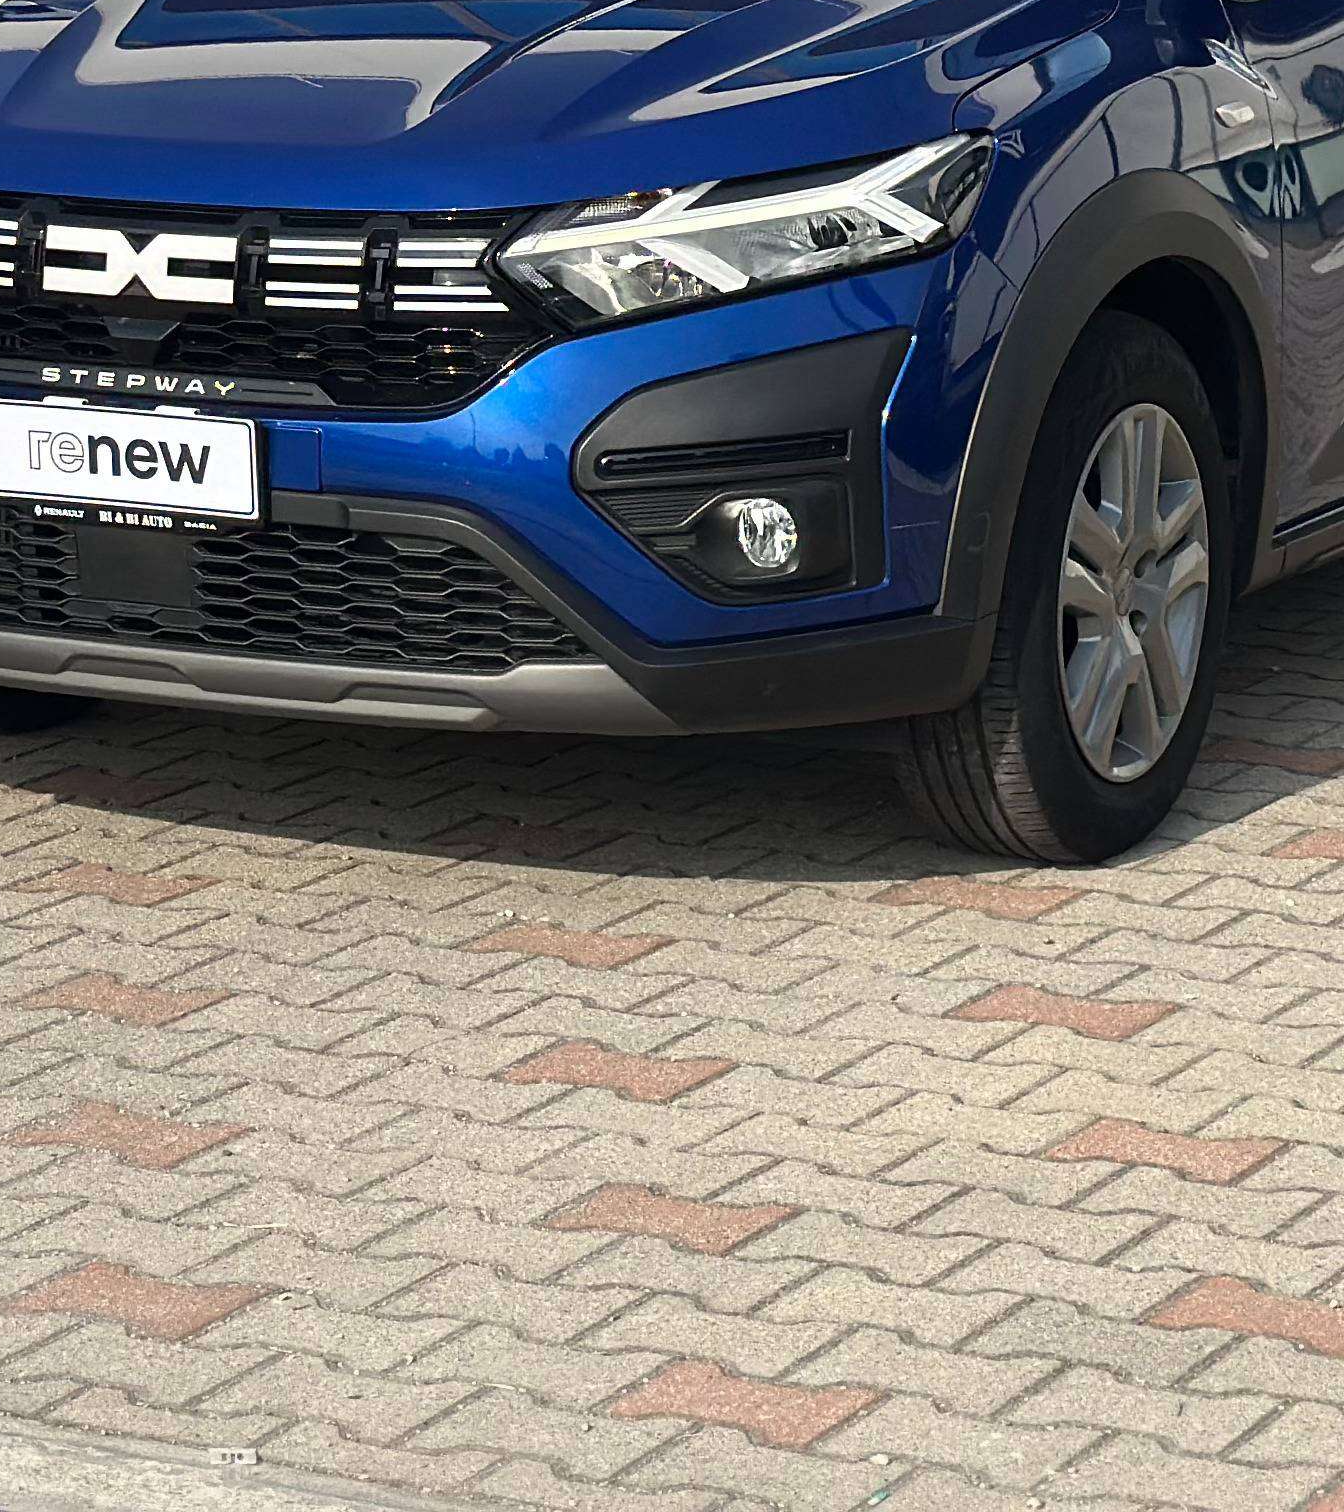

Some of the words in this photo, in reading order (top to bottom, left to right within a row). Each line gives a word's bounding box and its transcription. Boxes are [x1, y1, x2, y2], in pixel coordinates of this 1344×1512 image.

[41, 367, 235, 396] STEPWAY
[27, 430, 211, 485] renew
[99, 510, 113, 522] BI
[115, 511, 123, 524] &
[125, 512, 140, 525] BI
[141, 514, 173, 528] AUTO
